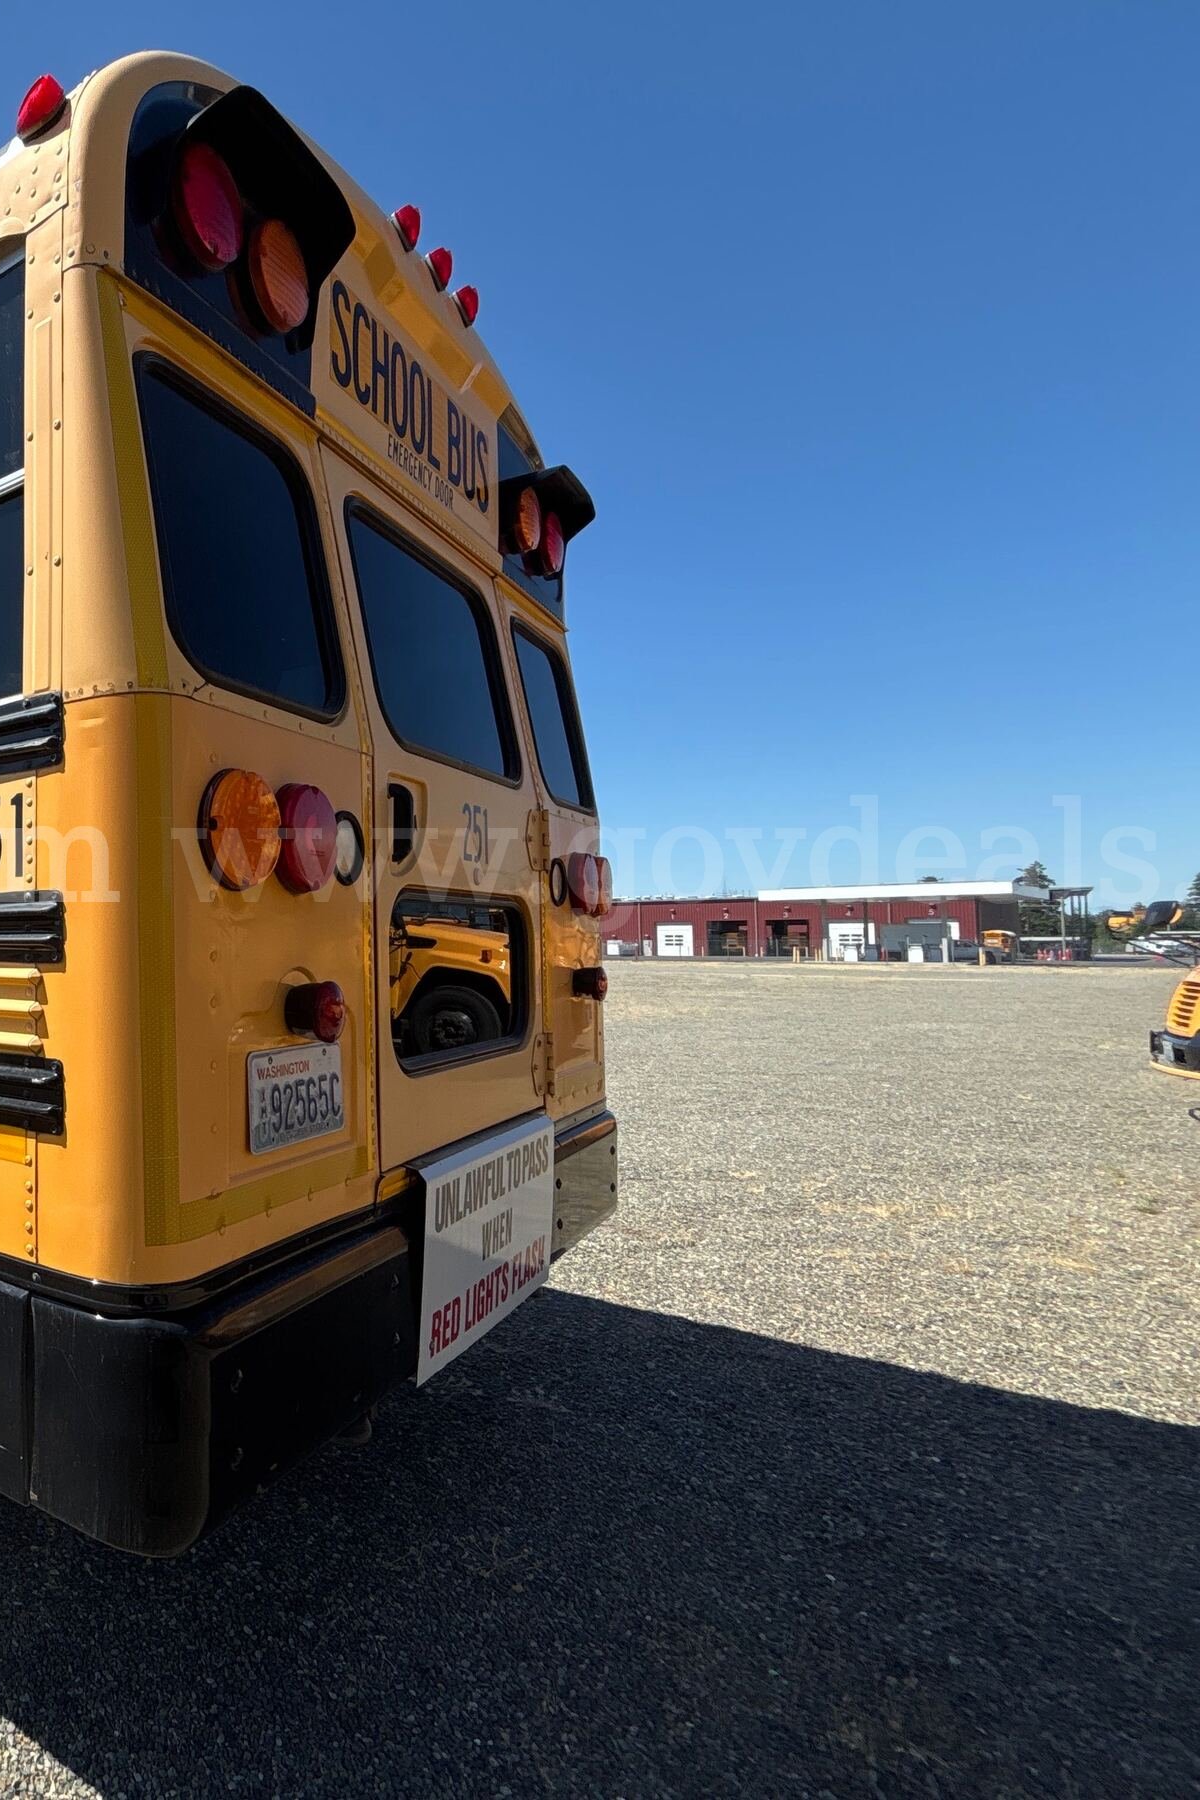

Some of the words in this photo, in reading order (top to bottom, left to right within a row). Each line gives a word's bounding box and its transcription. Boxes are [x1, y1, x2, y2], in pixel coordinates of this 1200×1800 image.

[331, 279, 440, 471] SCHOOL
[447, 398, 489, 514] BUS
[388, 433, 432, 491] EMERGENCY
[434, 475, 454, 511] DOOR
[462, 803, 488, 864] 251
[256, 1060, 310, 1081] WASHINGTON
[271, 1073, 341, 1133] 92565C
[434, 1155, 506, 1233] UNLAWFUL
[507, 1144, 521, 1193] TO
[521, 1134, 549, 1184] PASS
[482, 1207, 513, 1262] WHEN
[430, 1296, 460, 1359] RED
[464, 1260, 508, 1332] LIGHTS
[511, 1234, 546, 1295] FLASH
